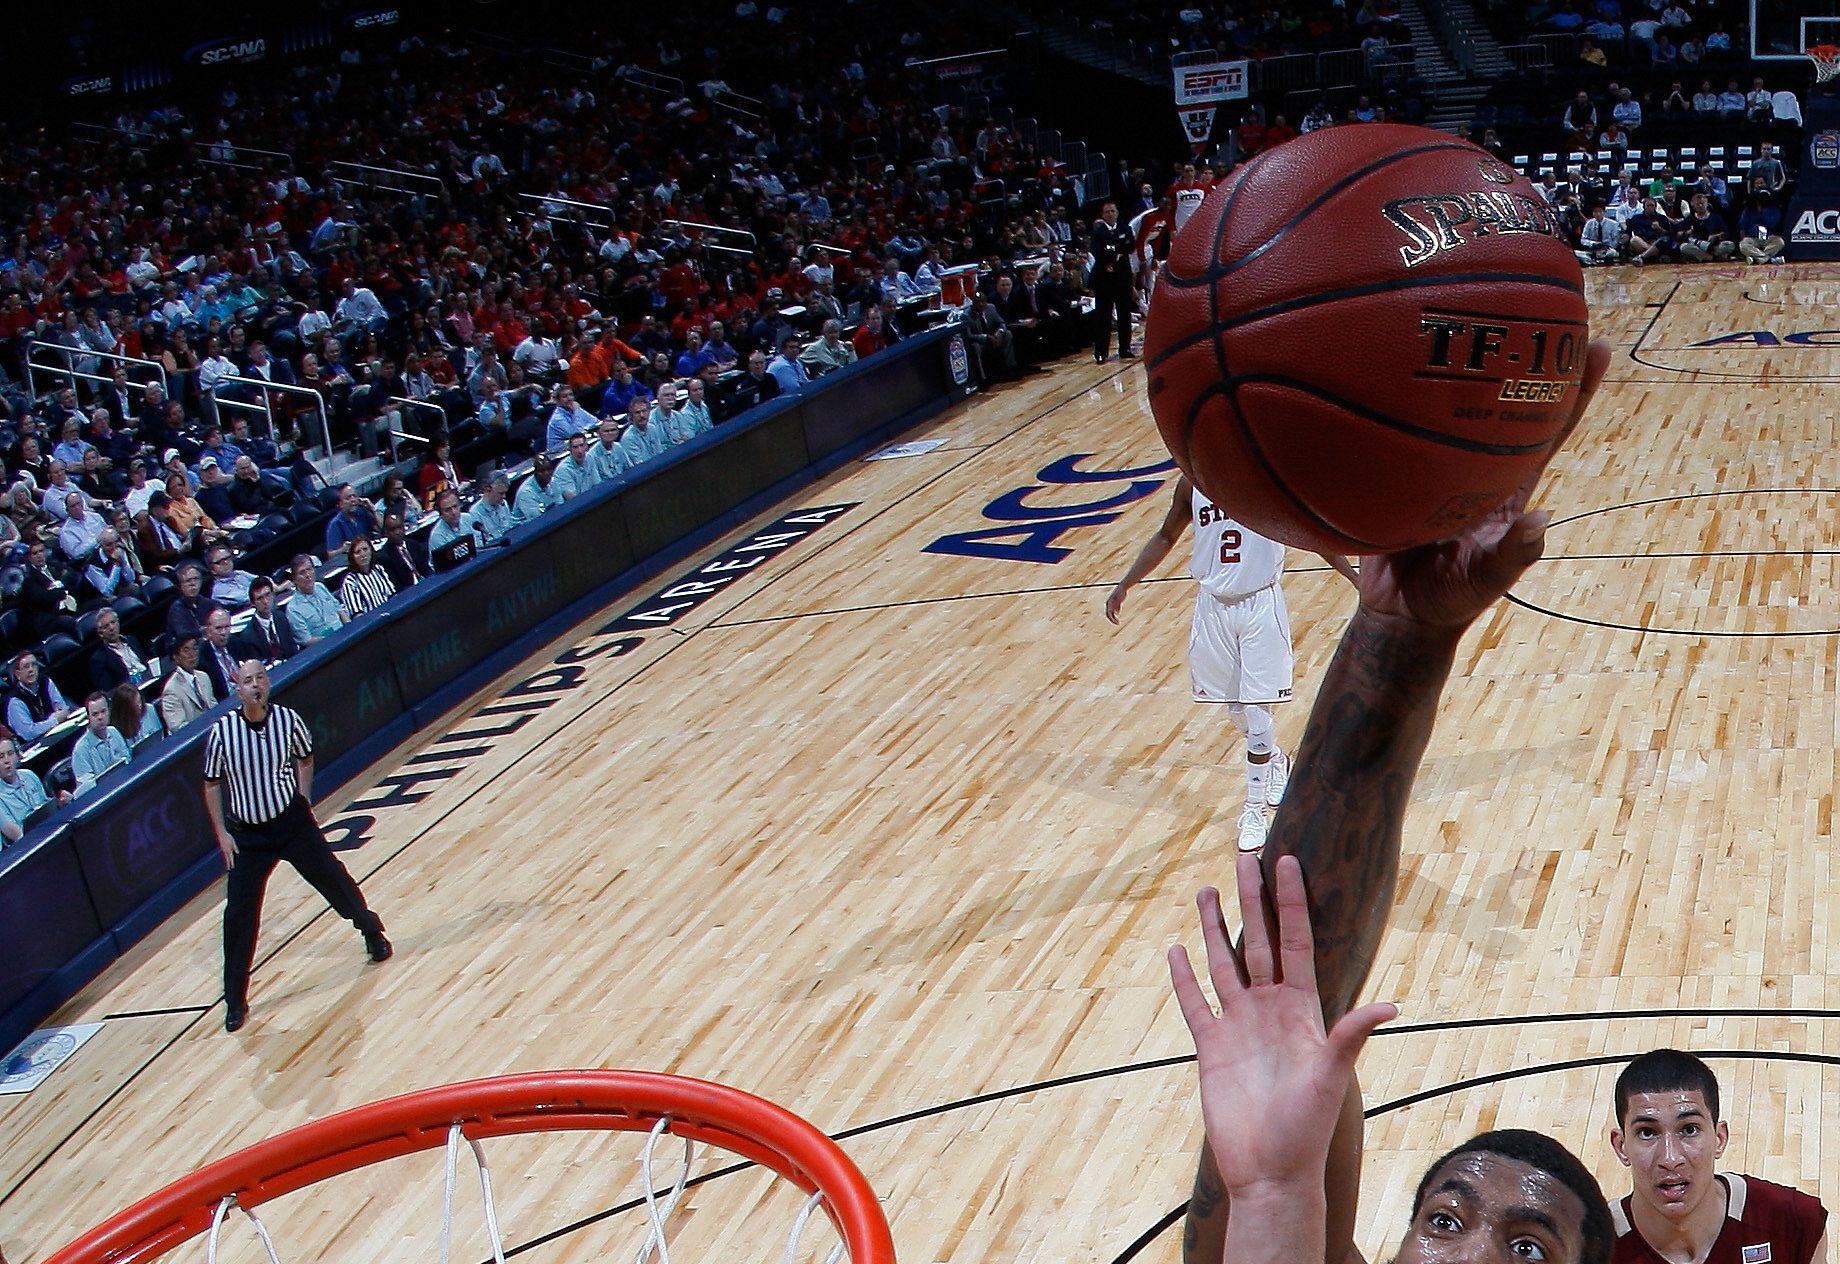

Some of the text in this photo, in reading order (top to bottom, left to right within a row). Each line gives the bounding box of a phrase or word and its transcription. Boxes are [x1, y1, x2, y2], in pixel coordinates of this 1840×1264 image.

[200, 38, 266, 64] SCANA
[1184, 68, 1242, 89] ESPN
[1498, 379, 1569, 403] LEGACY
[920, 453, 1183, 565] ACC
[1220, 529, 1242, 563] 2
[320, 634, 643, 853] PHILIPS
[626, 507, 846, 628] ARENA
